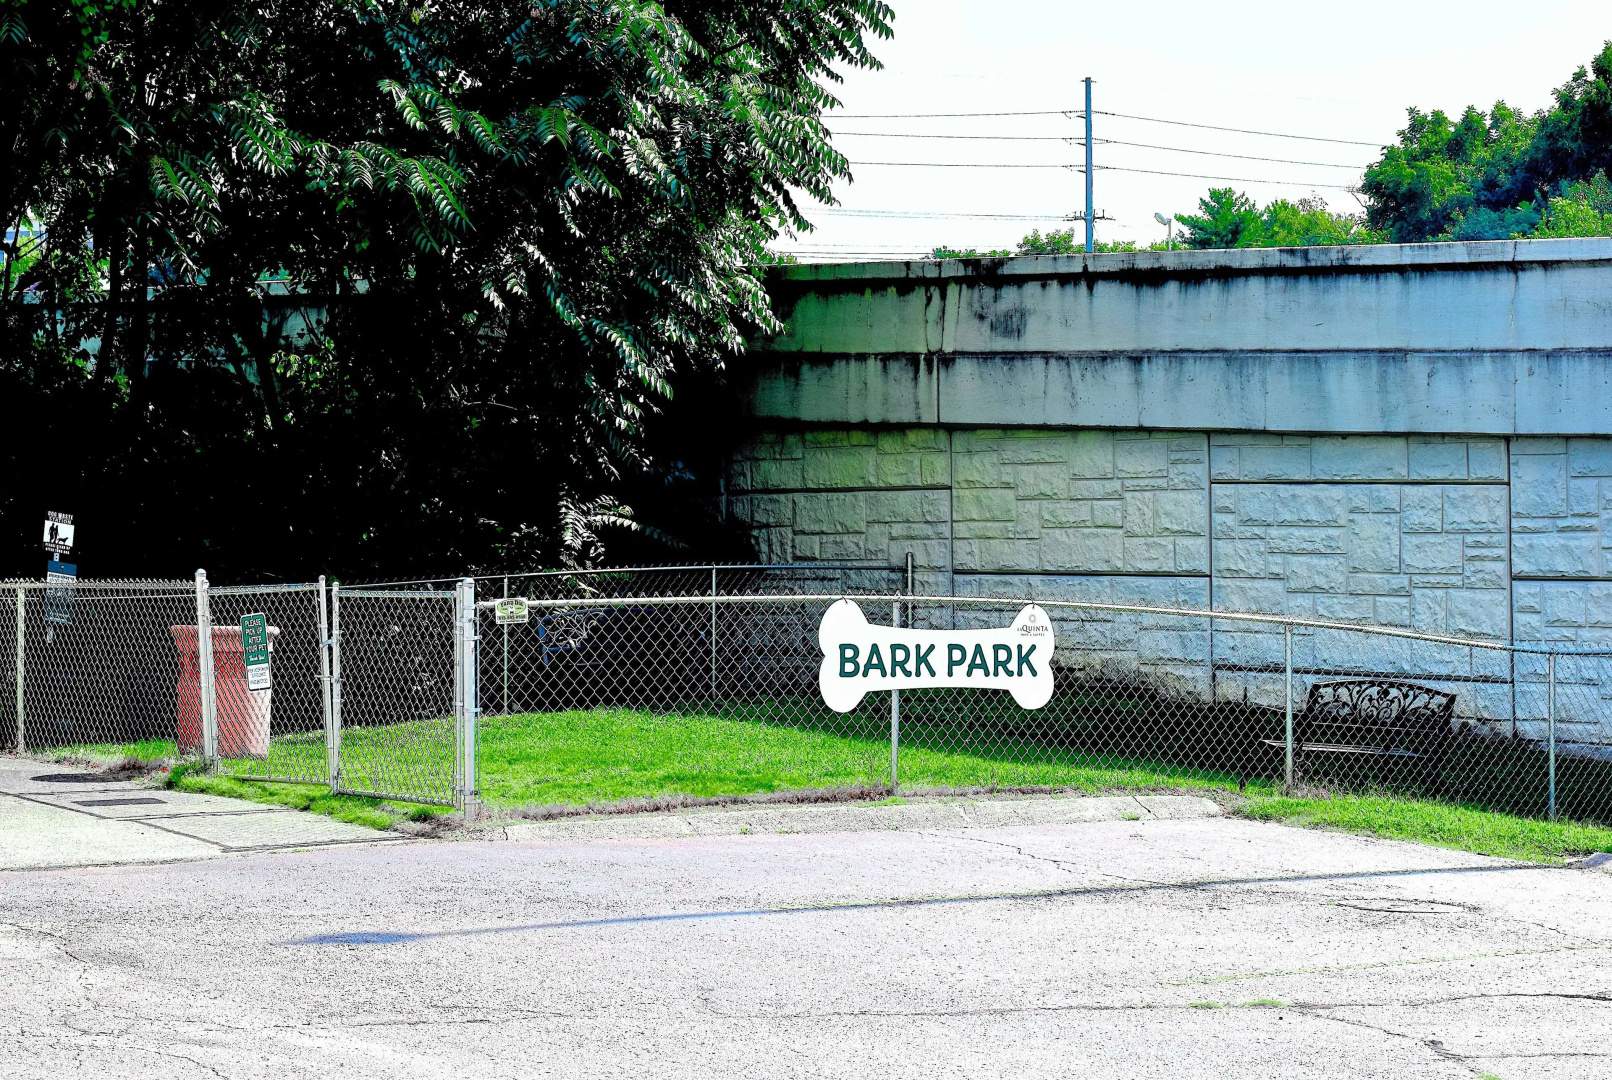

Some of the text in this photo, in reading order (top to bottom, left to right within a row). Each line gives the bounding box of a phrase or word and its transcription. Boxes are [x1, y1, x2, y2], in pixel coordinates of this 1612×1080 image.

[245, 618, 262, 626] PLEASE
[1021, 624, 1049, 634] QUINTA
[248, 636, 262, 644] AFTER
[245, 645, 258, 653] YOUR
[838, 643, 1037, 678] BARK PARK
